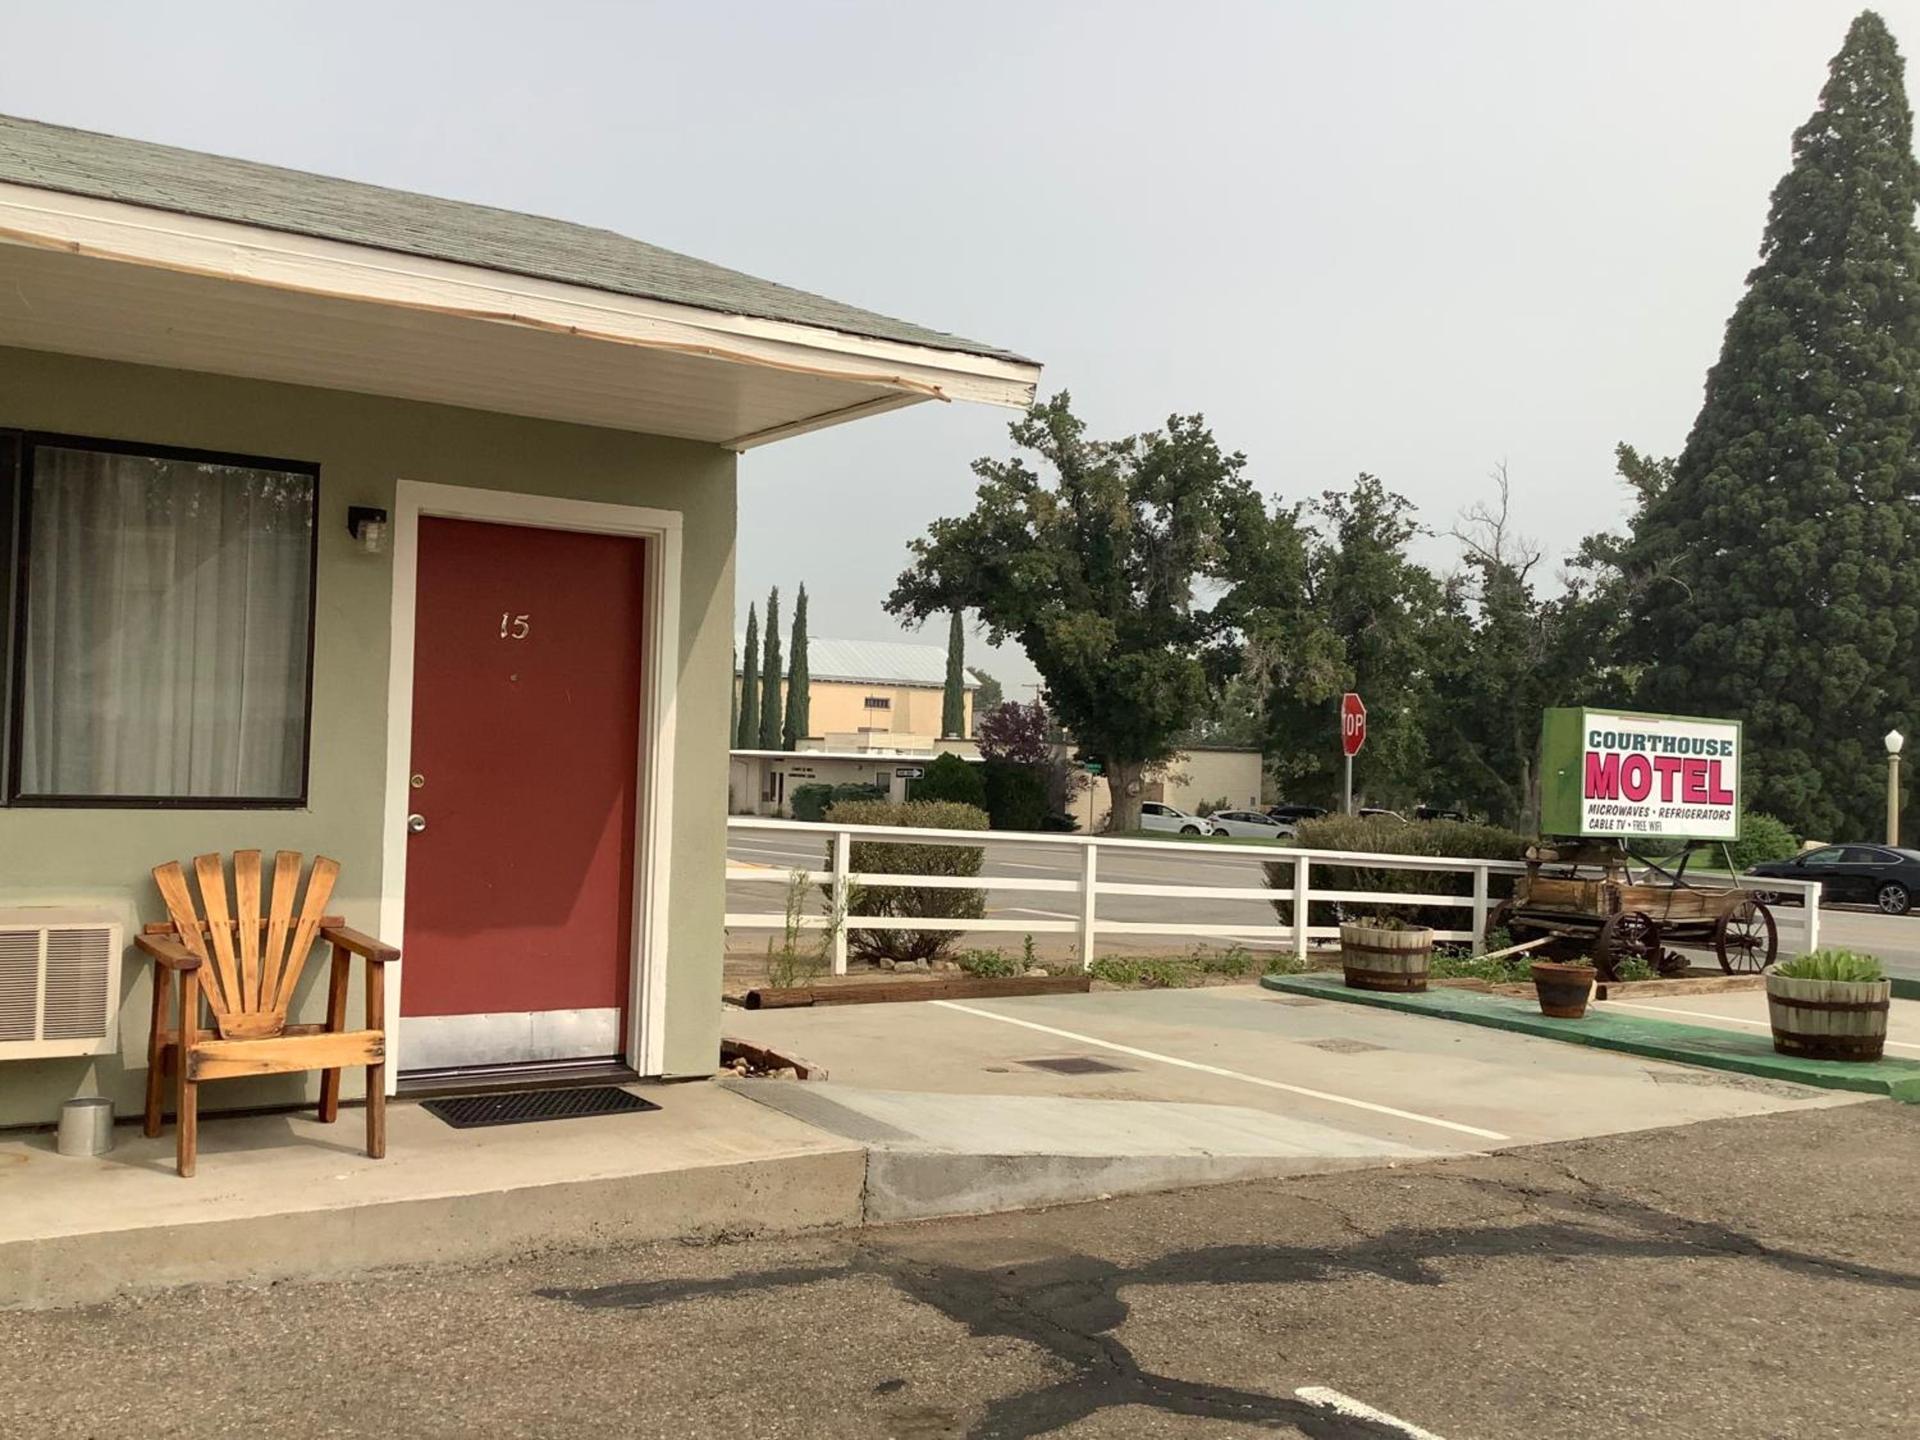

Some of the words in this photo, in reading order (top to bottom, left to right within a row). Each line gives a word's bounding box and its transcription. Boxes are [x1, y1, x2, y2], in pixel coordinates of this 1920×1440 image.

[500, 612, 530, 639] 15
[1589, 730, 1733, 757] COURTHOUSE
[1585, 752, 1733, 805] MOTEL
[1588, 804, 1650, 817] MICROWAVES
[1658, 808, 1731, 821] REFRIGERATORS
[1589, 818, 1613, 830] CABLE
[1616, 820, 1626, 830] TV
[1632, 820, 1647, 831] FREE
